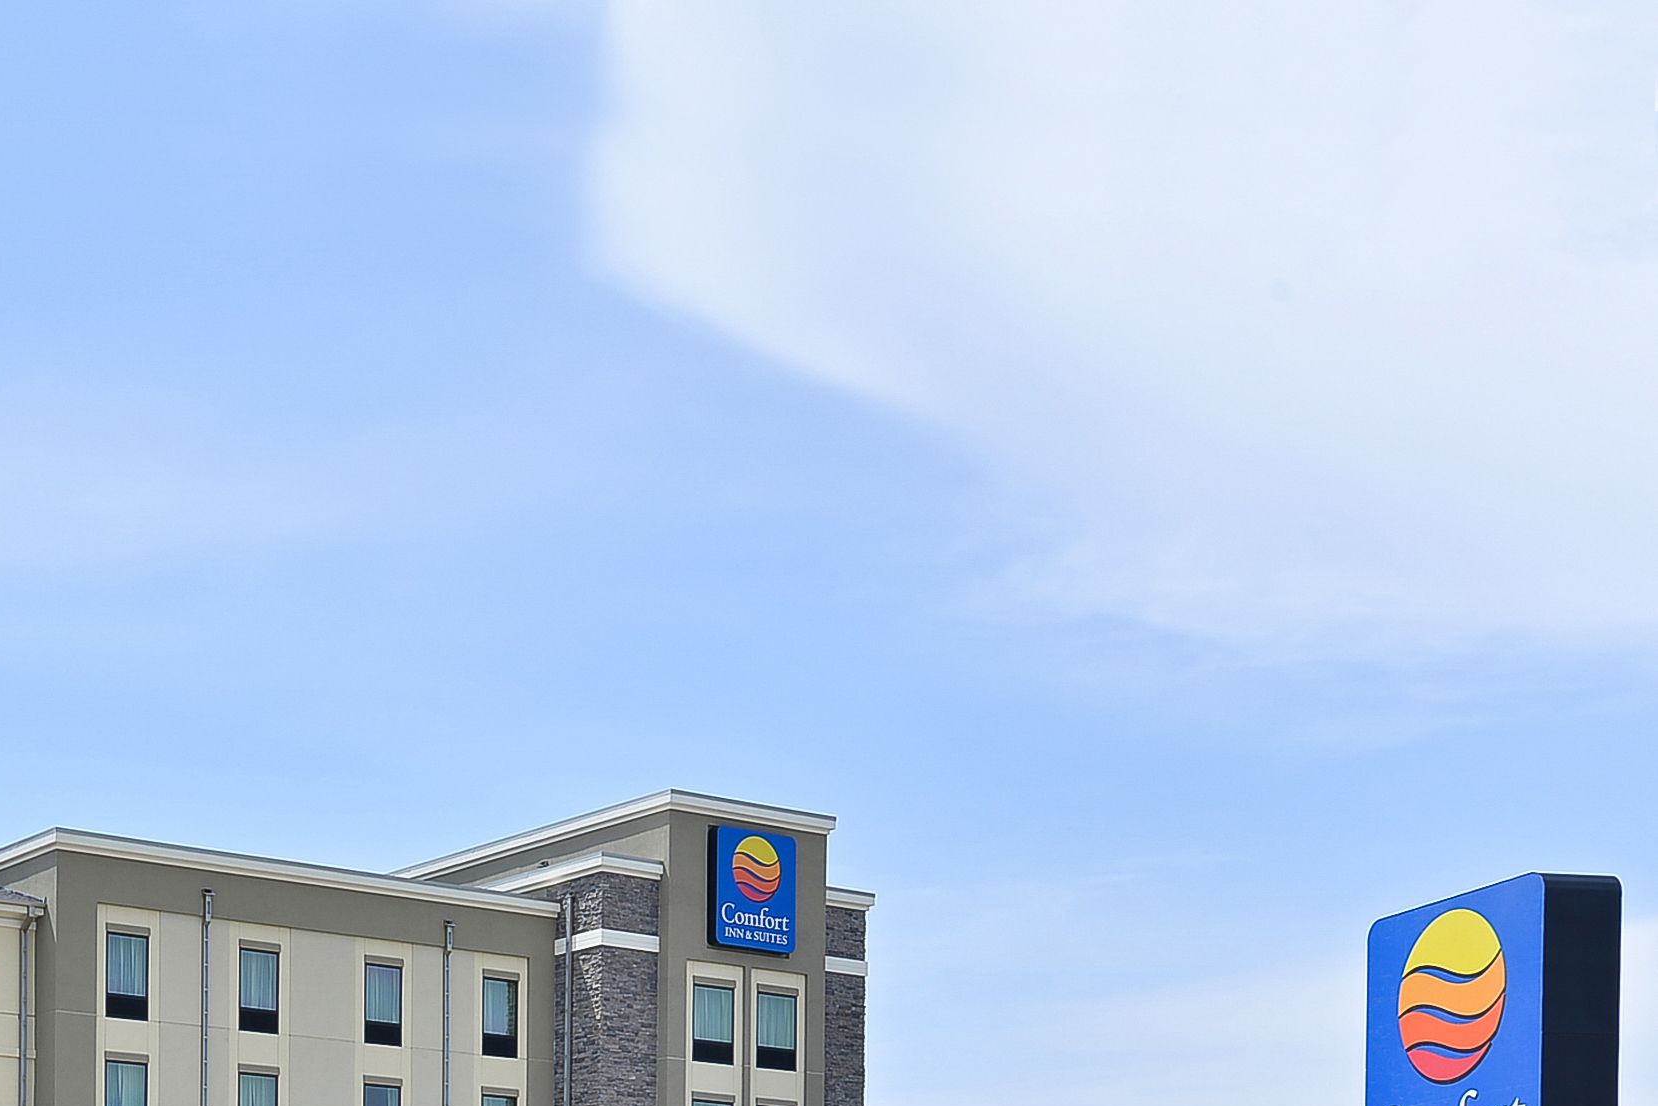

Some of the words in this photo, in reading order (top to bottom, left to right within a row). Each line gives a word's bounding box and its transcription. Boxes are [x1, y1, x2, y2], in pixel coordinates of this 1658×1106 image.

[721, 902, 790, 931] Comfort
[724, 926, 745, 939] INN
[745, 930, 753, 940] &
[753, 931, 788, 945] SUITES
